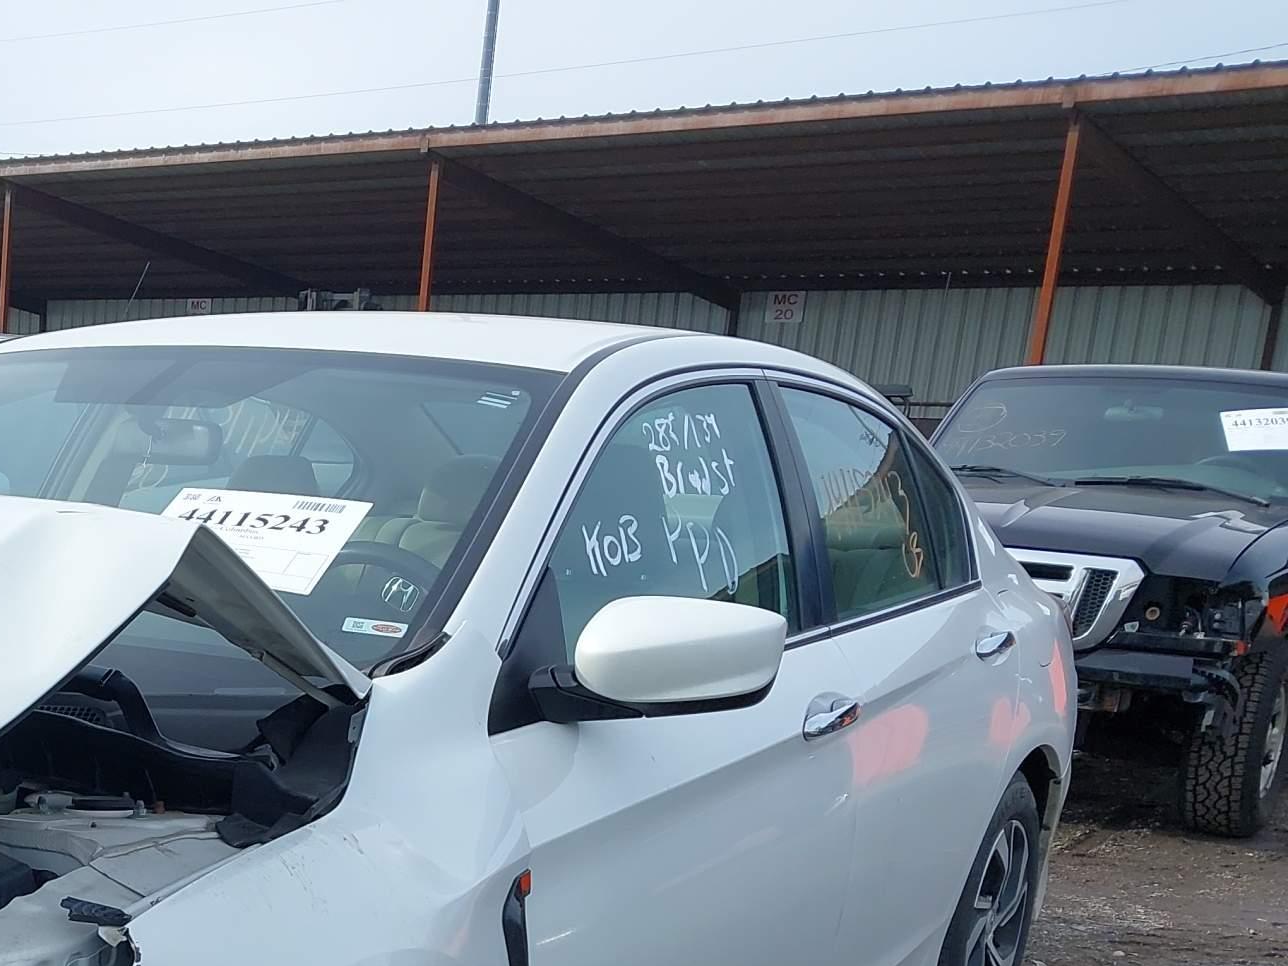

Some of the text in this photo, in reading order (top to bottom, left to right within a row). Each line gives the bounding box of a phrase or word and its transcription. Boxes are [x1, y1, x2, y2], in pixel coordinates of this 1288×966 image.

[773, 293, 799, 305] MC
[191, 300, 208, 311] MC
[774, 308, 794, 321] 20
[1231, 416, 1288, 428] 4413203
[178, 507, 330, 535] 44115243
